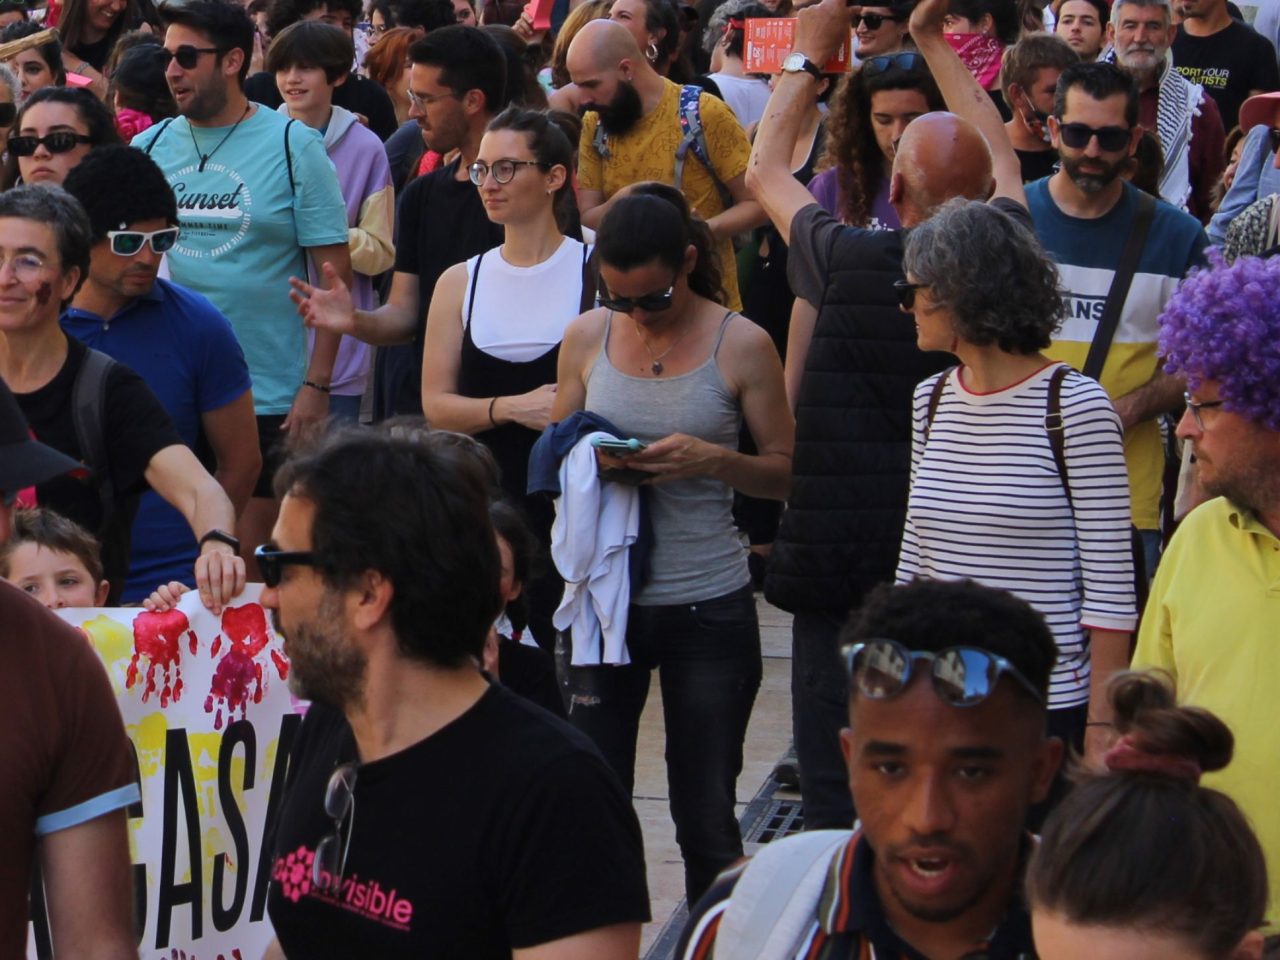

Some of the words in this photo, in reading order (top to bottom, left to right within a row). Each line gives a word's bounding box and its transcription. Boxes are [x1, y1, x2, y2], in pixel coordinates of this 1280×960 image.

[1202, 67, 1230, 79] YOUR
[1057, 298, 1106, 321] ANS
[314, 871, 413, 923] nvisible
